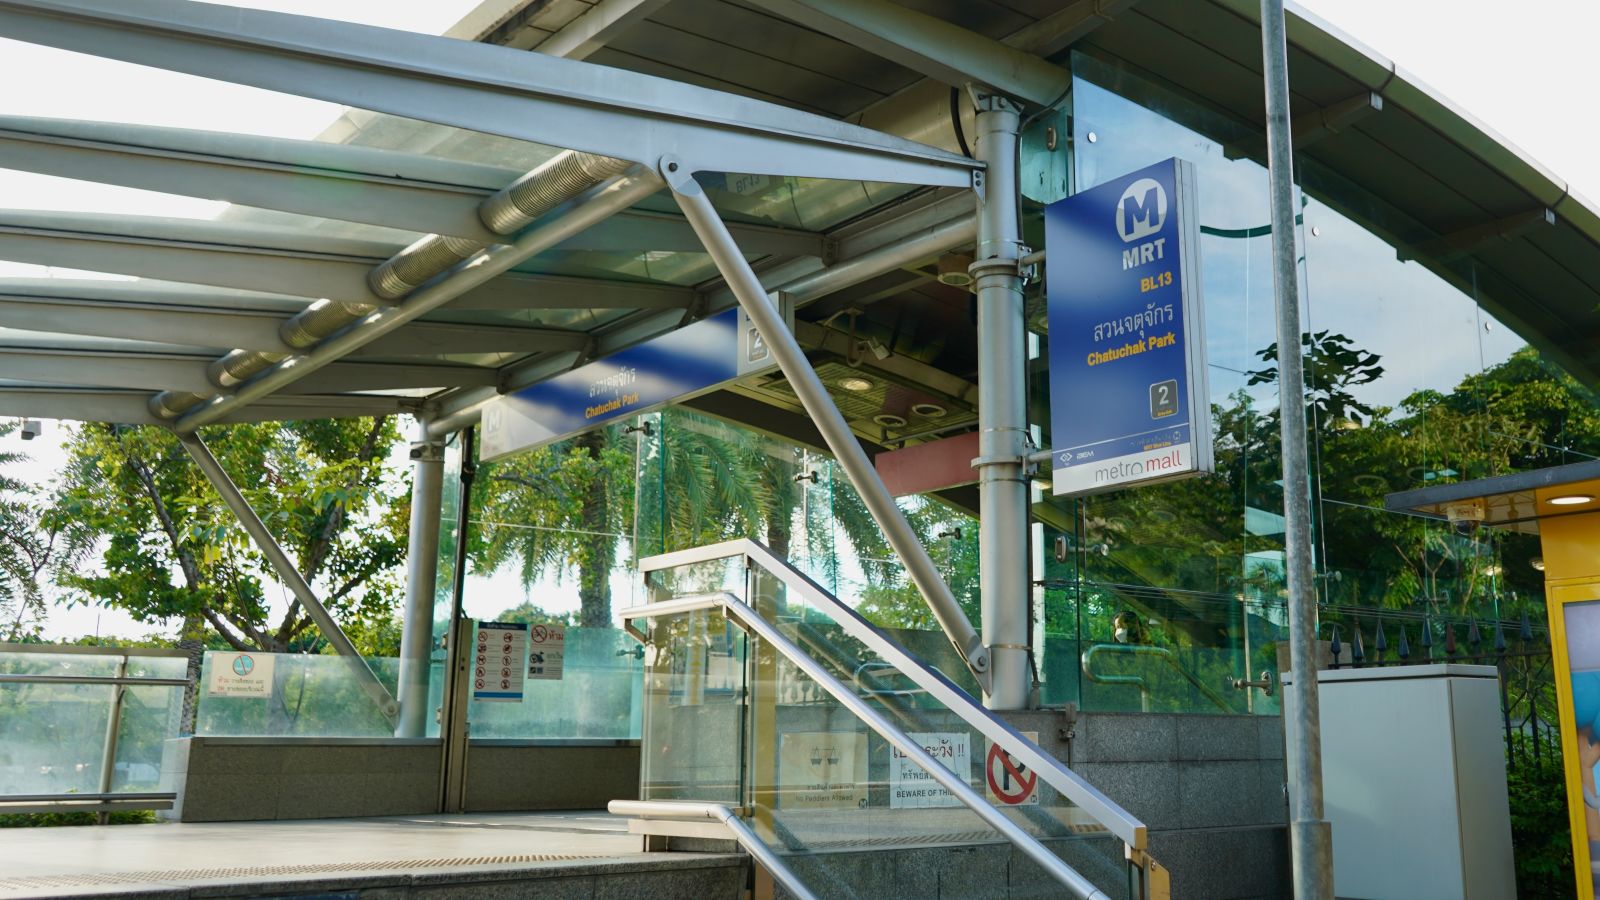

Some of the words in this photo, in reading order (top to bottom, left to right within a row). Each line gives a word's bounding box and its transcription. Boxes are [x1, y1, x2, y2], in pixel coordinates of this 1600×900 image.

[1123, 238, 1166, 271] MRT
[1141, 271, 1173, 293] BL13
[1094, 302, 1173, 342] สวนจตุจักร
[1087, 339, 1148, 367] Chatuchak
[1148, 331, 1176, 352] Park
[585, 400, 622, 419] Chatuchak
[622, 392, 640, 407] Park
[1158, 386, 1170, 405] 2
[1146, 449, 1182, 473] mall
[896, 790, 926, 798] BEWARE
[927, 789, 936, 797] OF
